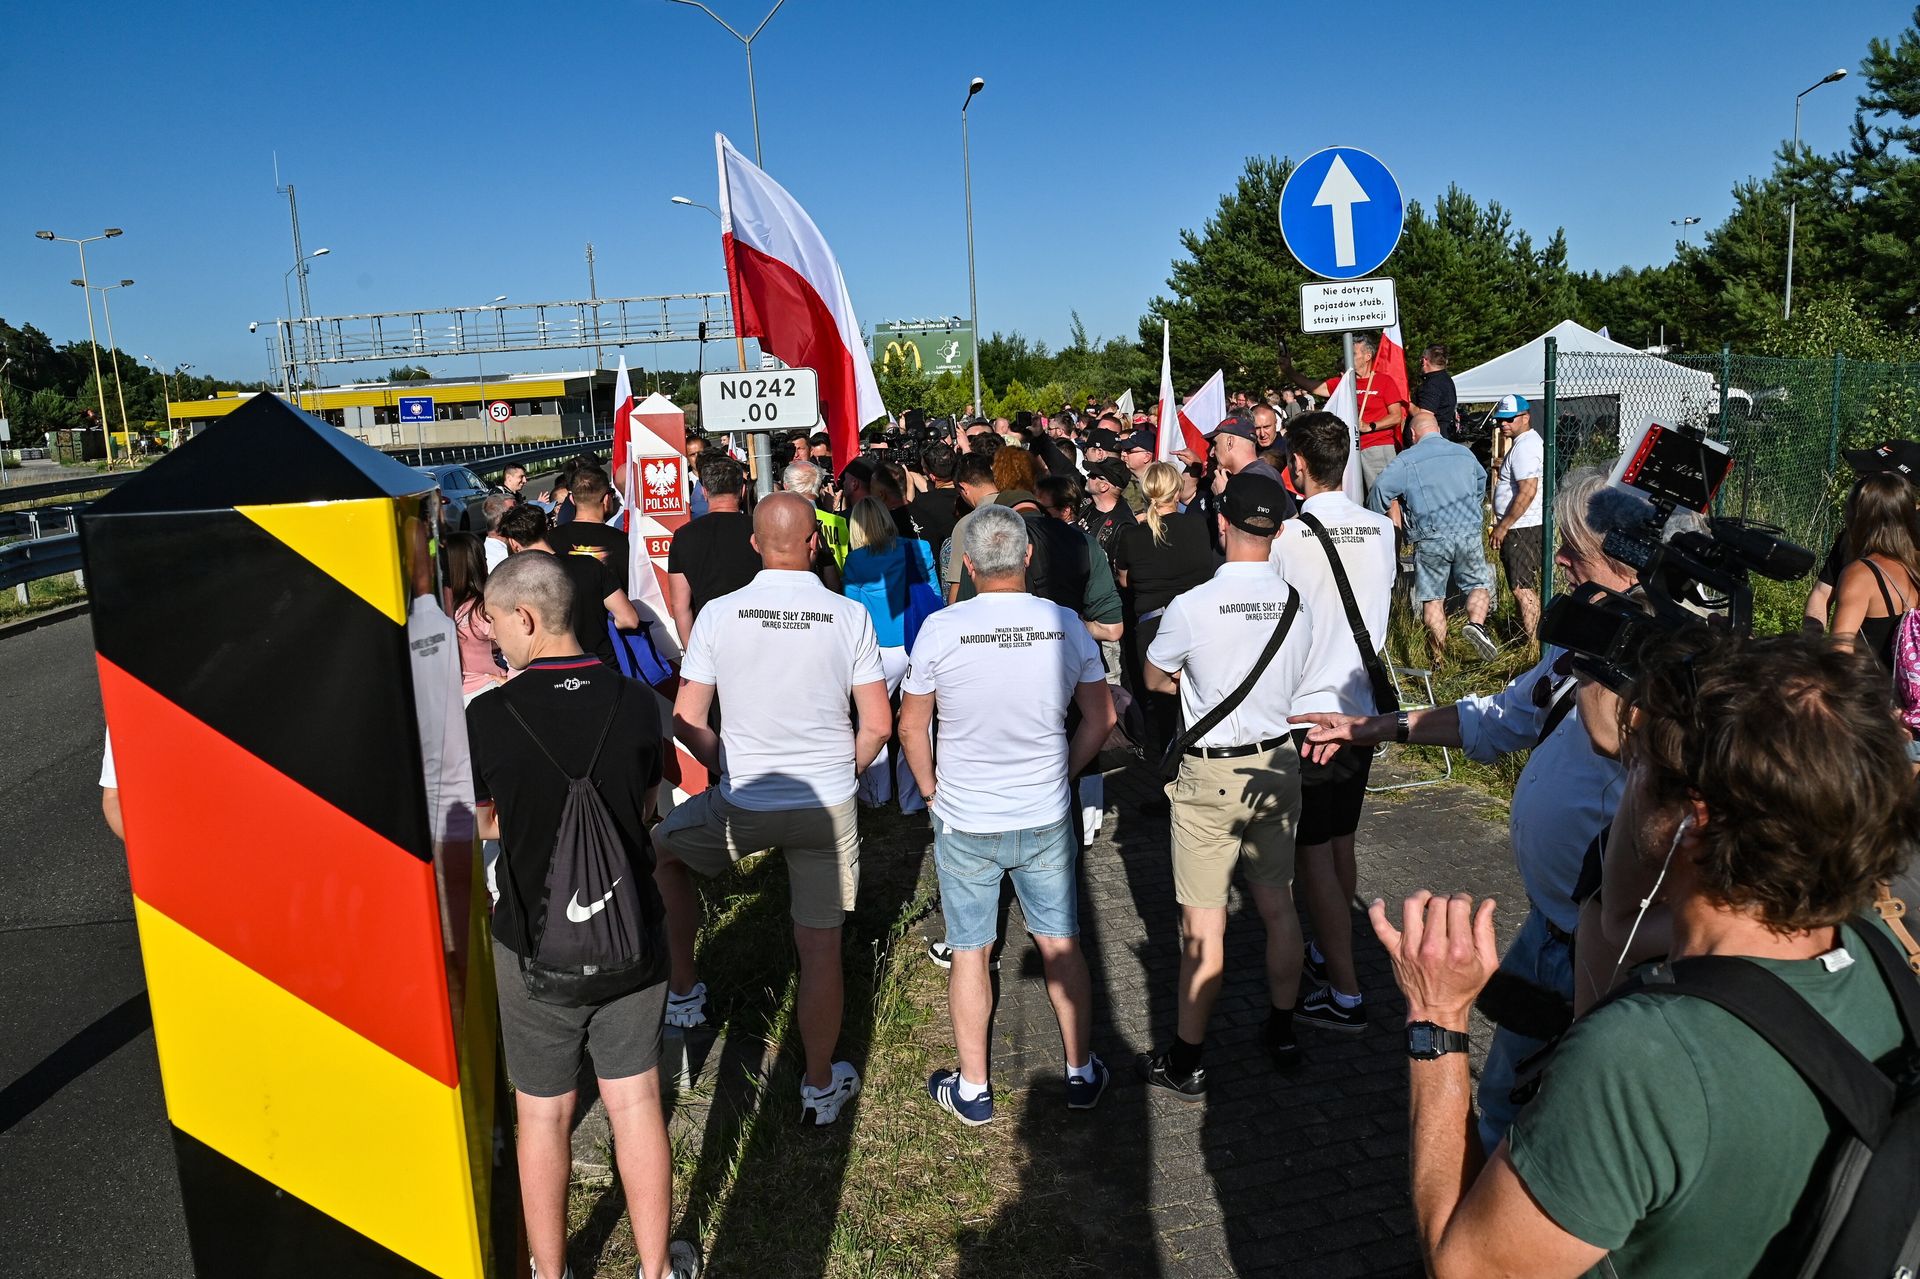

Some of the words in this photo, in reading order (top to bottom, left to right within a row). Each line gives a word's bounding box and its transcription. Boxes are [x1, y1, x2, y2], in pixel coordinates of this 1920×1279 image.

[1322, 287, 1338, 296] Nie
[1341, 286, 1374, 295] dotyczy
[1313, 300, 1356, 312] pojazdów
[1313, 315, 1339, 325] straży
[1341, 314, 1345, 322] i
[1347, 311, 1387, 322] inspekcji
[720, 378, 796, 400] N0242
[493, 406, 507, 417] 50
[741, 402, 778, 422] .00
[645, 498, 681, 510] POLSKA
[1340, 526, 1354, 536] SIŁY
[1355, 527, 1382, 536] ZBROJNE
[1219, 603, 1261, 615] NARODOWE
[1262, 602, 1277, 611] SIŁY
[738, 609, 782, 620] NARODOWE
[782, 611, 799, 621] SIŁY
[800, 612, 834, 624] ZBROJNE
[1245, 613, 1263, 621] OKRĘG
[762, 620, 782, 630] OKRĘG
[782, 622, 811, 630] SZCZECIN
[960, 633, 1012, 645] NARODOWYCH
[1013, 633, 1025, 642] SIŁ
[1026, 631, 1066, 642] ZBROJNYCH
